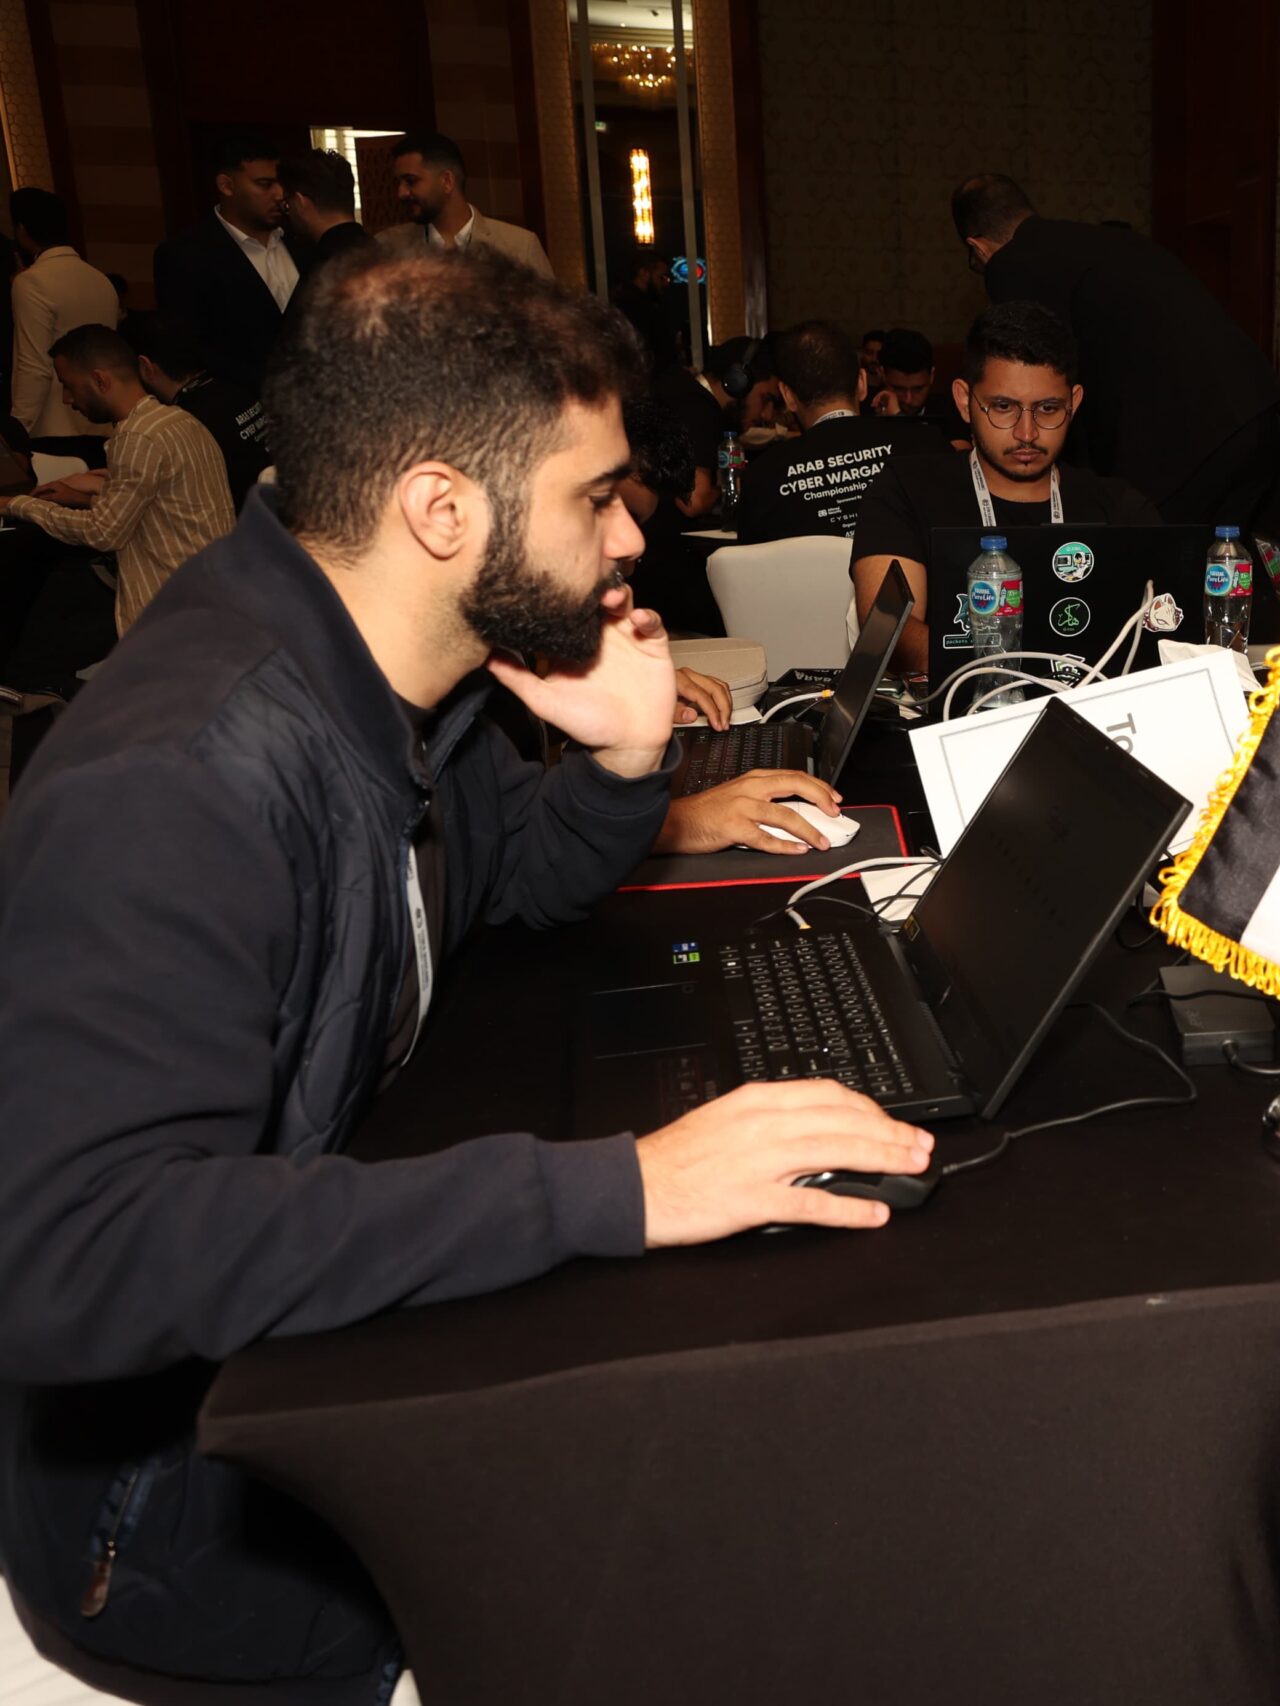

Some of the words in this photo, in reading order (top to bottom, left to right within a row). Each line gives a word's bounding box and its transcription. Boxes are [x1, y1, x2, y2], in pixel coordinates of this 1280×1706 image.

[787, 459, 825, 477] ARAB
[827, 444, 892, 468] SECURITY
[779, 475, 824, 496] CYBER
[803, 481, 868, 501] Championship
